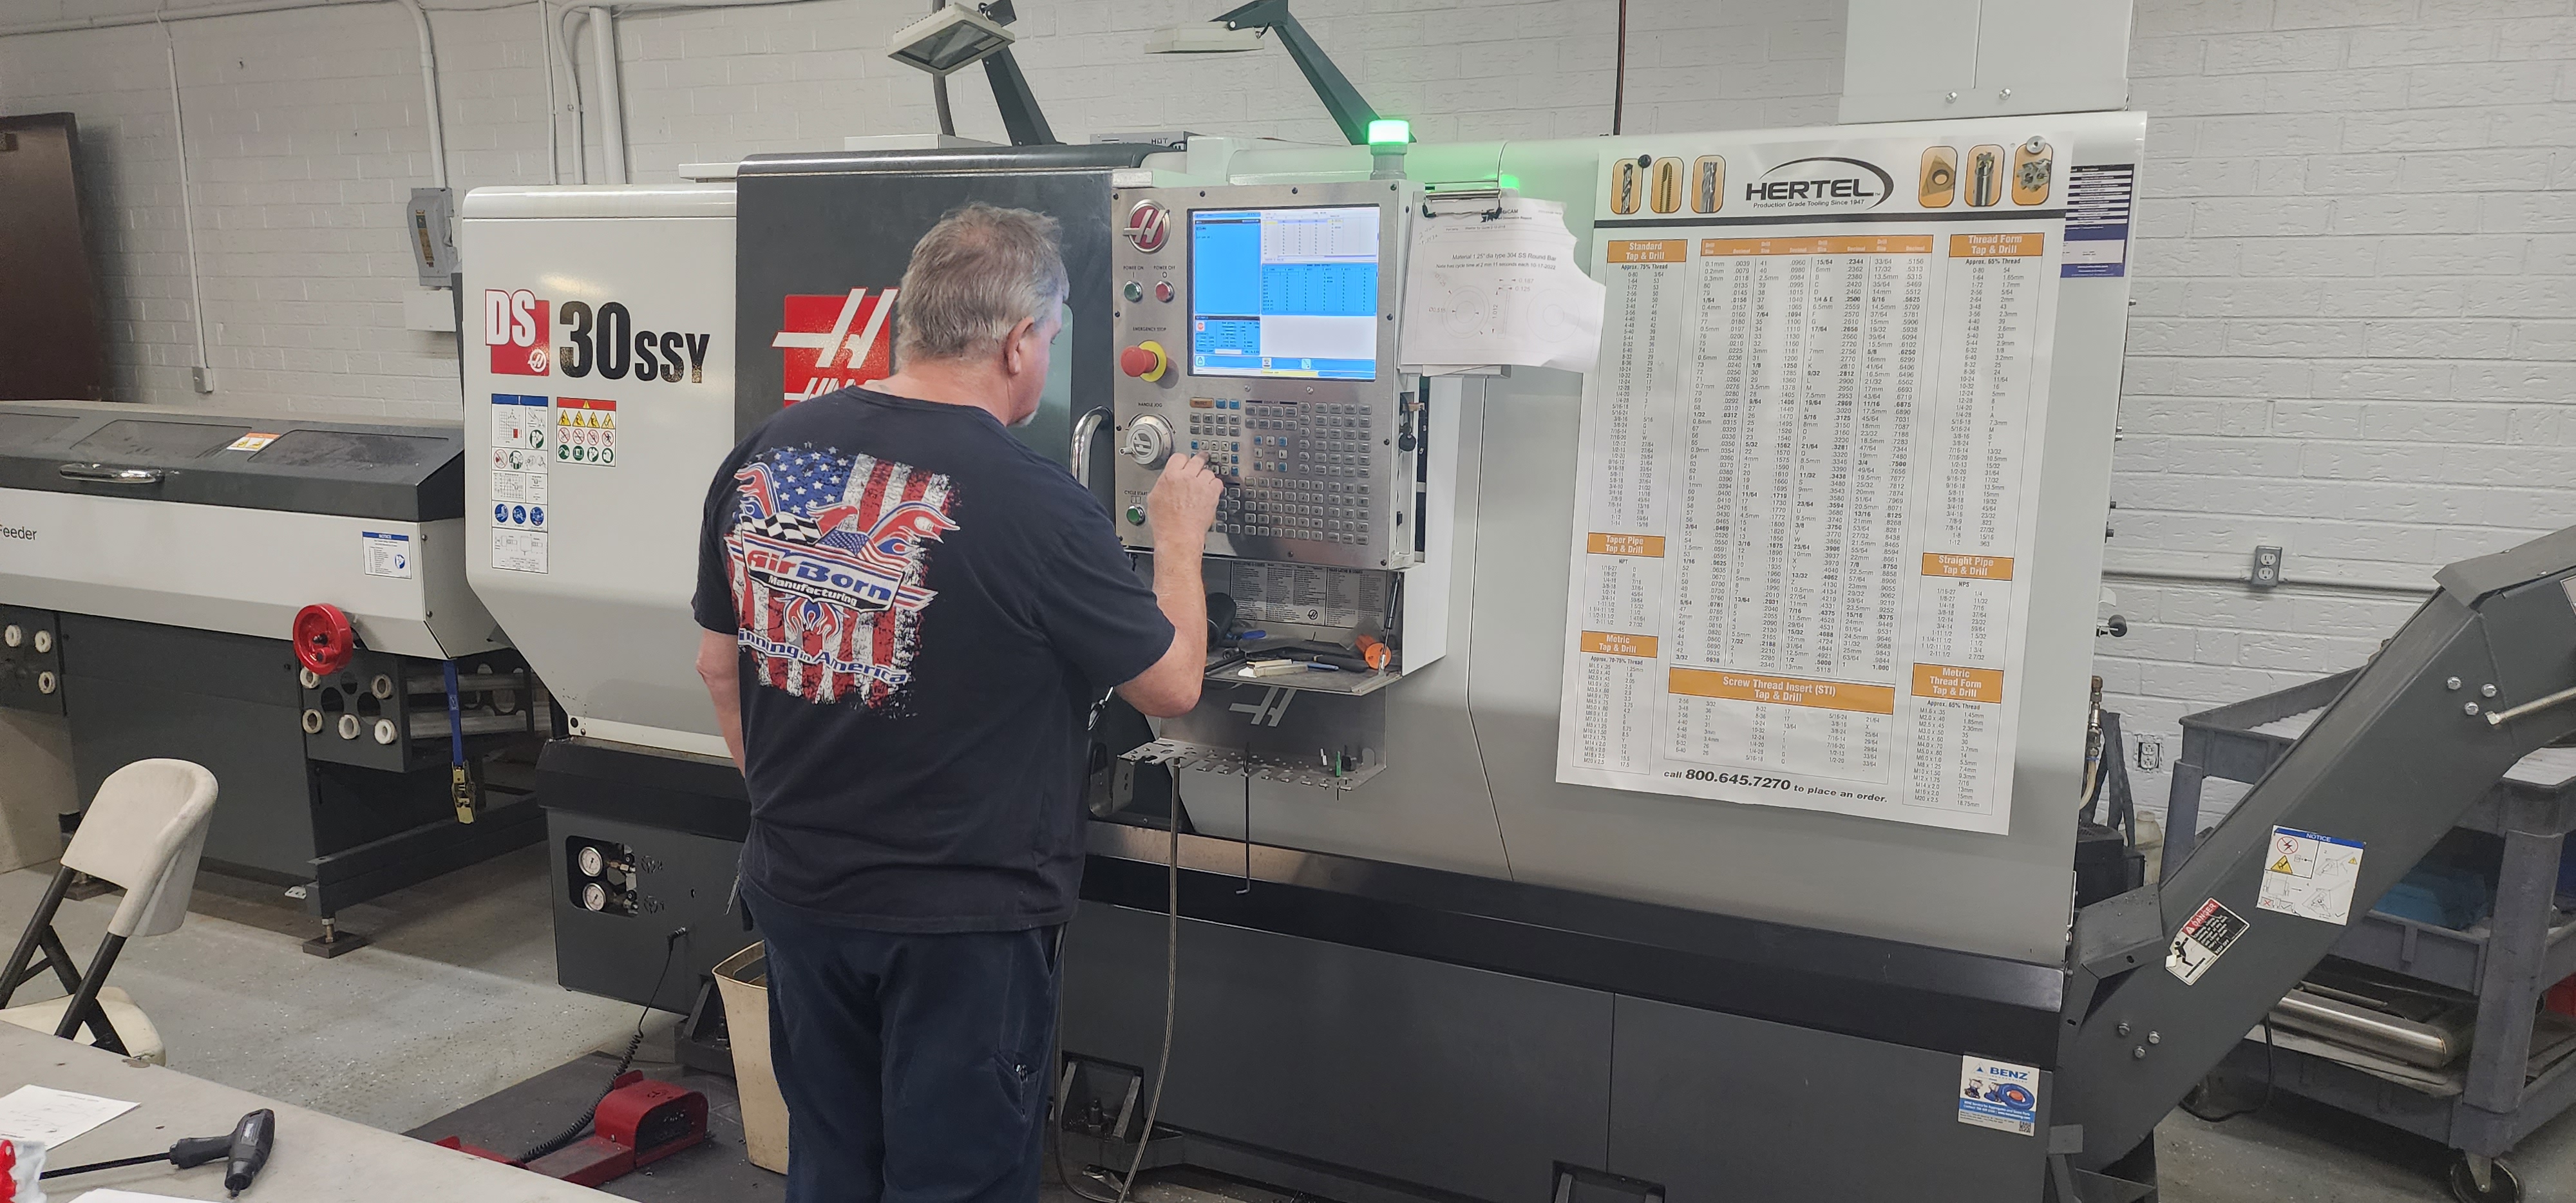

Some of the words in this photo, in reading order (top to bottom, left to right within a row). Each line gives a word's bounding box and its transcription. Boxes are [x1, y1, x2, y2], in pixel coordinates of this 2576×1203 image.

[1745, 178, 1874, 200] HERTEL
[1968, 235, 1997, 244] Thread
[2000, 234, 2022, 243] Form
[1629, 242, 1662, 251] Standard
[1971, 245, 1986, 256] Tap
[1989, 245, 1996, 254] &
[1998, 245, 2017, 254] Drill
[1625, 252, 1639, 261] Tap
[484, 288, 536, 347] DS
[1606, 535, 1625, 544] Taper
[1627, 536, 1643, 545] Pipe
[1605, 544, 1618, 553] Tap
[1627, 545, 1643, 554] Drill
[1938, 554, 1972, 566] Straight
[1974, 556, 1994, 567] Pipe
[1943, 565, 1958, 575] Tap
[1960, 566, 1967, 574] &
[1969, 567, 1987, 576] Drill
[768, 574, 858, 606] Manufacturing
[1606, 634, 1630, 643] Metric
[1599, 643, 1611, 652] Tap
[1621, 645, 1636, 653] Drill
[739, 629, 798, 658] inning
[799, 651, 811, 661] in
[813, 651, 907, 683] America
[1942, 667, 1970, 678] Metric
[1723, 676, 1750, 688] Screw
[1752, 678, 1784, 690] Thread
[1786, 682, 1813, 694] Insert
[1814, 685, 1836, 697] (STI)
[1929, 676, 1958, 686] Thread
[1960, 679, 1982, 688] Form
[1754, 688, 1770, 701] Tap
[1772, 690, 1781, 700] &
[1782, 690, 1802, 702] Drill
[1933, 685, 1947, 696] Tap
[1958, 688, 1977, 697] Drill
[1663, 770, 1682, 779] call
[1685, 768, 1791, 791] 800.645.7270
[1793, 784, 1804, 793] to
[1807, 786, 1837, 799] place
[1857, 791, 1888, 803] order.
[2306, 833, 2331, 842] NOTICE
[2192, 903, 2215, 926] DANGER
[1990, 1066, 2028, 1080] BENZ
